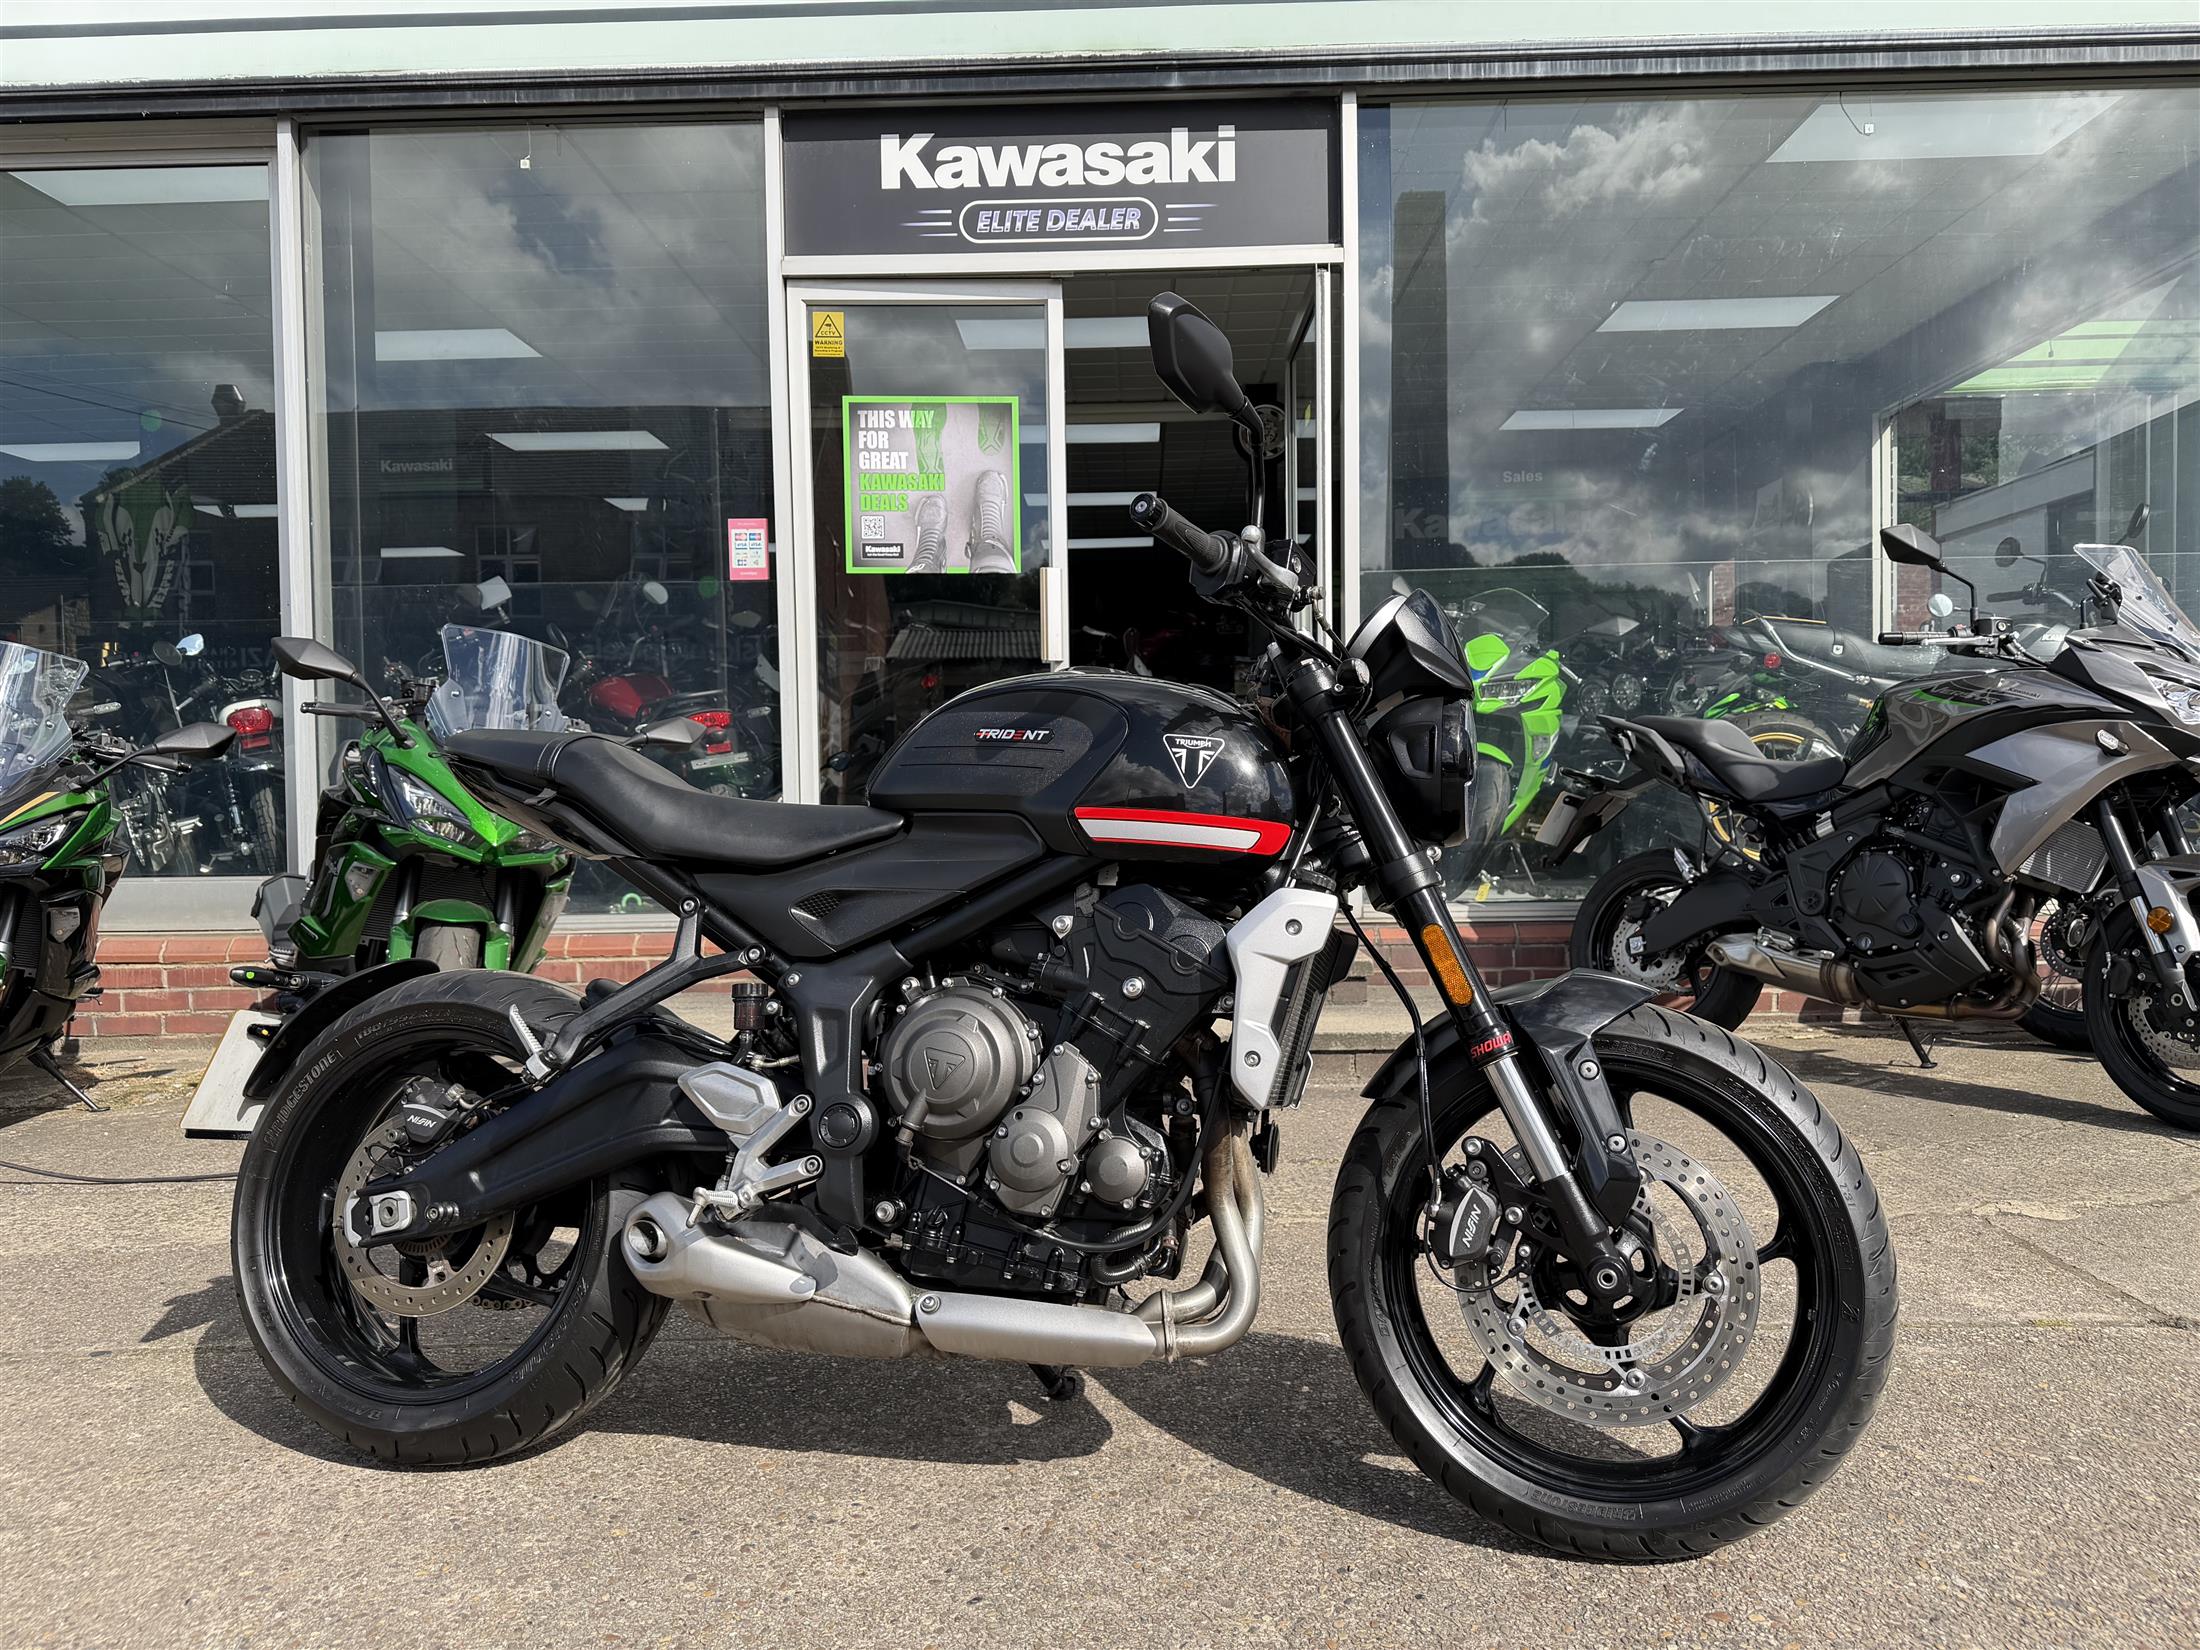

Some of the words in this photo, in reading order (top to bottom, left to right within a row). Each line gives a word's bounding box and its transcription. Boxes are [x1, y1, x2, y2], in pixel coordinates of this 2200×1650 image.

[881, 124, 1236, 190] Kawasaki
[977, 209, 1045, 233] ELITE
[1046, 207, 1142, 231] DEALER
[857, 409, 896, 429] THIS
[897, 409, 935, 429] WAY
[858, 430, 889, 449] FOR
[380, 458, 454, 472] Kawasaki
[858, 451, 909, 470] GREAT
[859, 472, 945, 491] KAWASAKI
[1503, 470, 1543, 483] Sales
[859, 493, 909, 512] DEALS
[865, 545, 901, 553] Kawasaki
[976, 728, 1050, 741] TRIDENT
[1175, 738, 1212, 748] TRIUMPH
[1470, 1031, 1513, 1059] SHOWA
[263, 1049, 338, 1147] BRIDGESTONE
[1531, 1489, 1637, 1522] BRIDGESTONE
